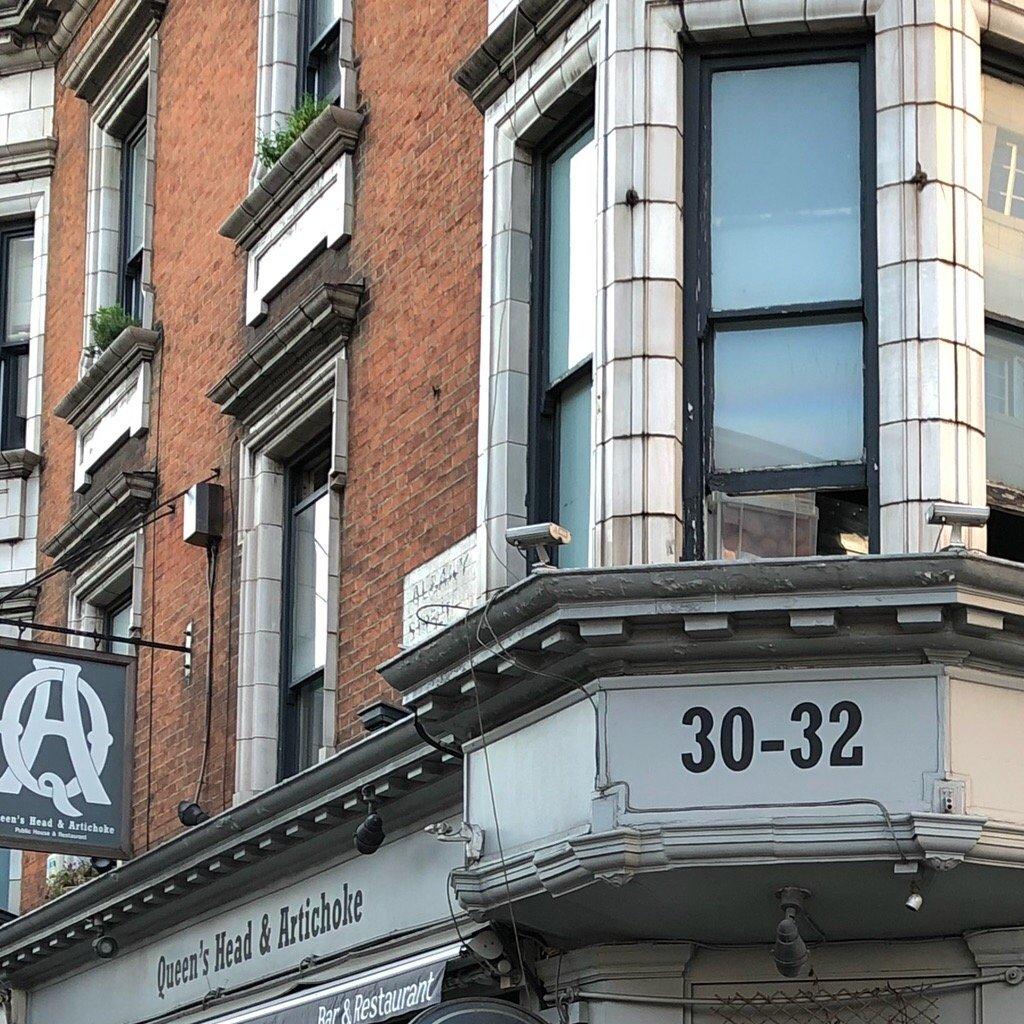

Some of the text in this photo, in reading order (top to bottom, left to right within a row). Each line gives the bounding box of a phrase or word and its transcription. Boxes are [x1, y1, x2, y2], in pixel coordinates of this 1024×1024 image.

[681, 700, 864, 774] 30-32
[29, 816, 53, 828] Head
[57, 819, 66, 829] &
[68, 820, 115, 835] Artichoke
[157, 883, 364, 1000] Queen's Head & Artichoke
[353, 971, 435, 1023] Restaurant
